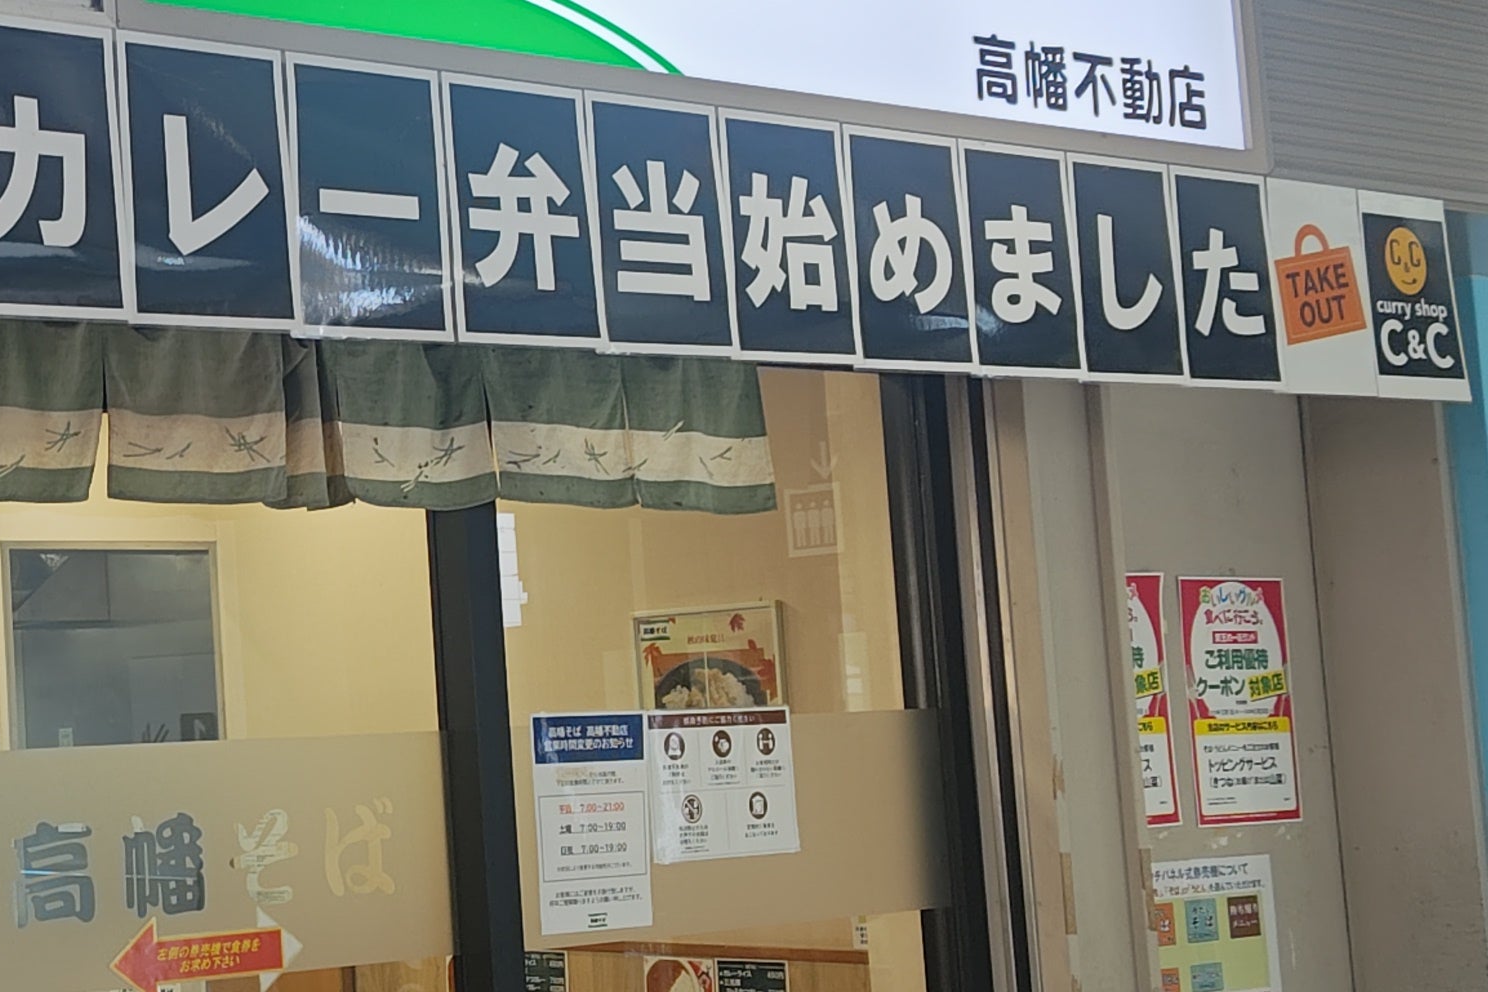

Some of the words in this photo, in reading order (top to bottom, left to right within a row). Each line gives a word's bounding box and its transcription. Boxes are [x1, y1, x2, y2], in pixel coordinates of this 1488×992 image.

[974, 35, 1207, 130] 高幡不動店
[1285, 263, 1347, 294] TAKE
[1299, 294, 1345, 328] OUT
[1376, 300, 1412, 320] curry
[1414, 298, 1448, 322] shop
[1380, 318, 1455, 369] C&C
[1196, 675, 1246, 697] クーポン
[12, 797, 398, 930] 高幡そば
[179, 957, 240, 973] お求め下さい
